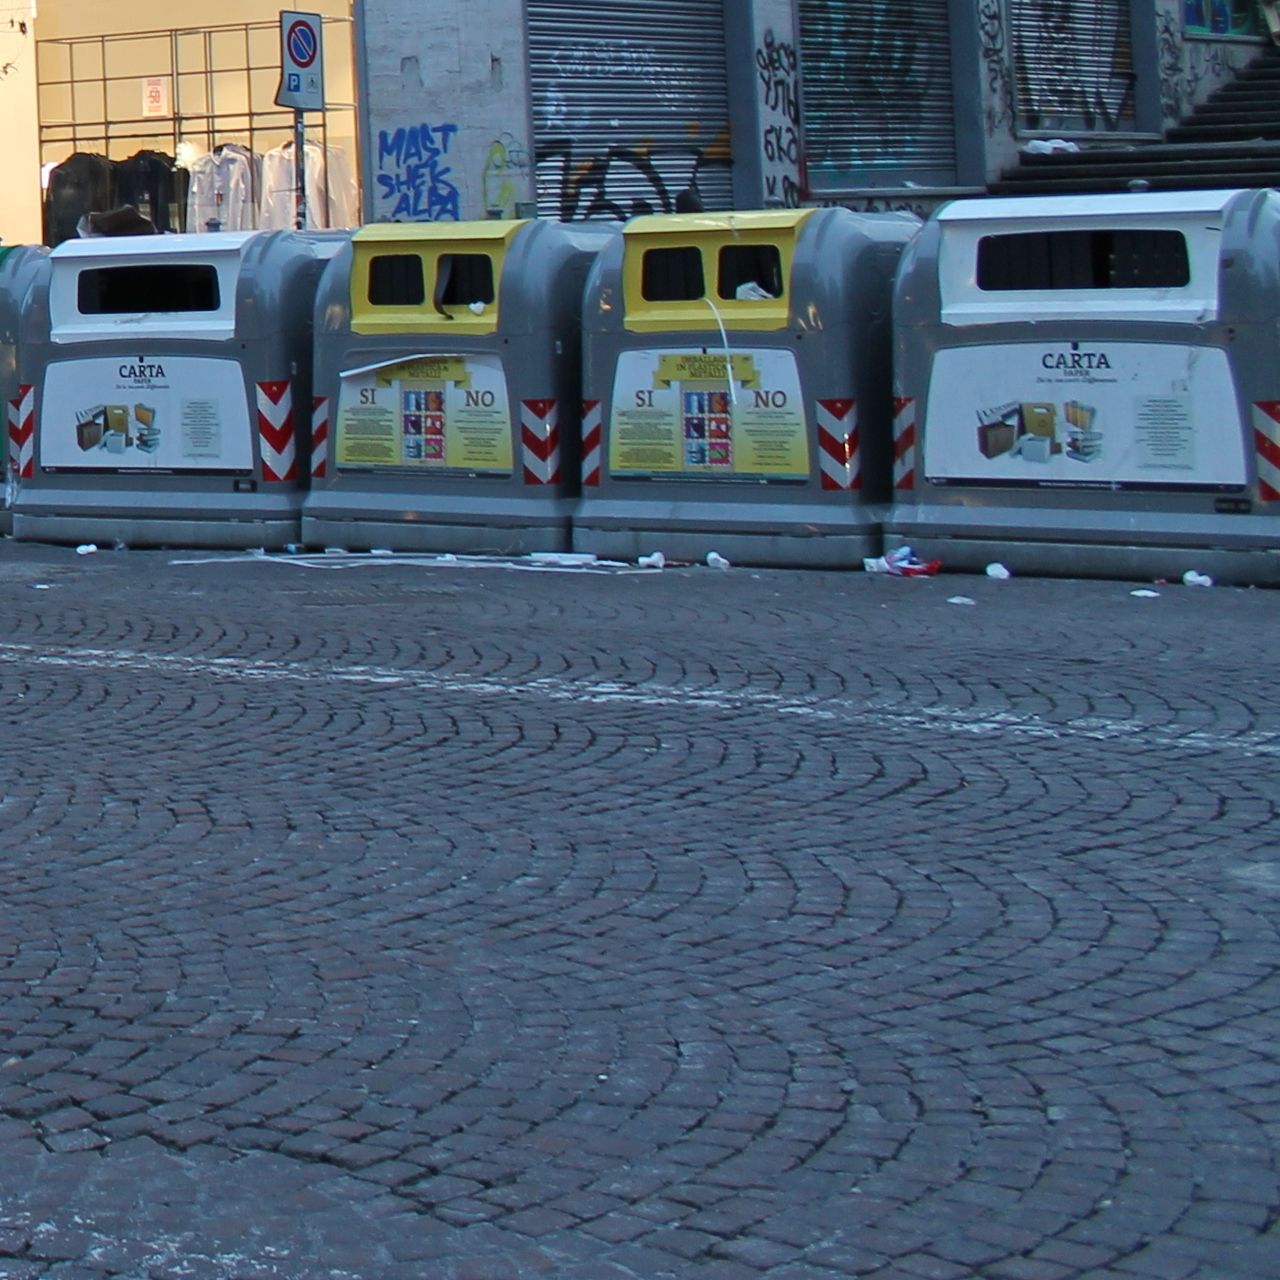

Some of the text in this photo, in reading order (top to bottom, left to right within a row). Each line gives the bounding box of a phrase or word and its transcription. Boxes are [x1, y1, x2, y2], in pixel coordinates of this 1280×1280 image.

[378, 122, 458, 170] MAST
[1042, 352, 1111, 369] CARTA
[119, 365, 166, 378] CARTA
[360, 388, 376, 405] SI
[464, 390, 495, 408] NO
[635, 390, 654, 408] SI
[753, 390, 787, 408] NO
